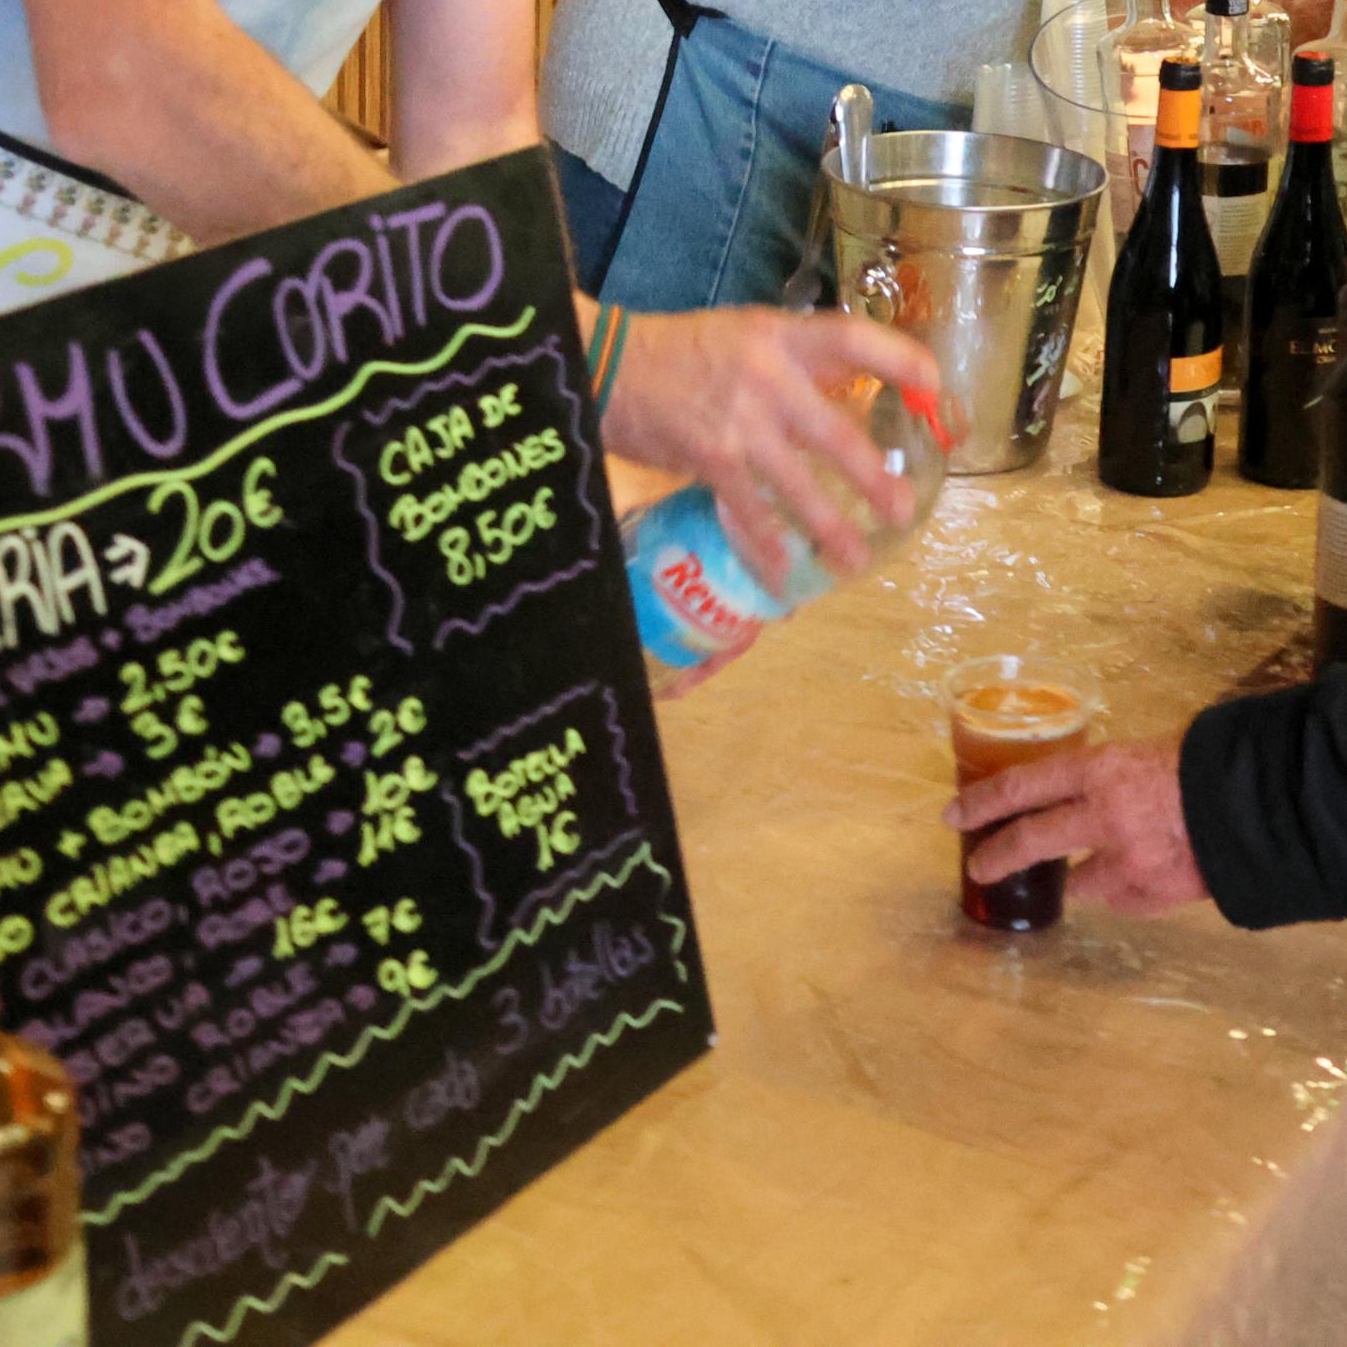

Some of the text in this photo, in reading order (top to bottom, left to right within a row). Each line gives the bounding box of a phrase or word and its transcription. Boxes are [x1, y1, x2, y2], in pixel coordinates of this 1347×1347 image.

[202, 201, 505, 421] CORITO
[379, 382, 522, 486] CAJA DE
[146, 457, 284, 595] 20€
[438, 486, 557, 586] 8,50€
[118, 630, 246, 714] 2,50€
[130, 694, 209, 760] 3€
[280, 674, 372, 748] 3,5€
[368, 696, 427, 758] 2€
[362, 755, 438, 816] 10€
[357, 806, 422, 868] 11€
[536, 810, 581, 872] 1€
[272, 897, 349, 961] 16€
[362, 898, 422, 946] 7€
[377, 949, 438, 997] 9€
